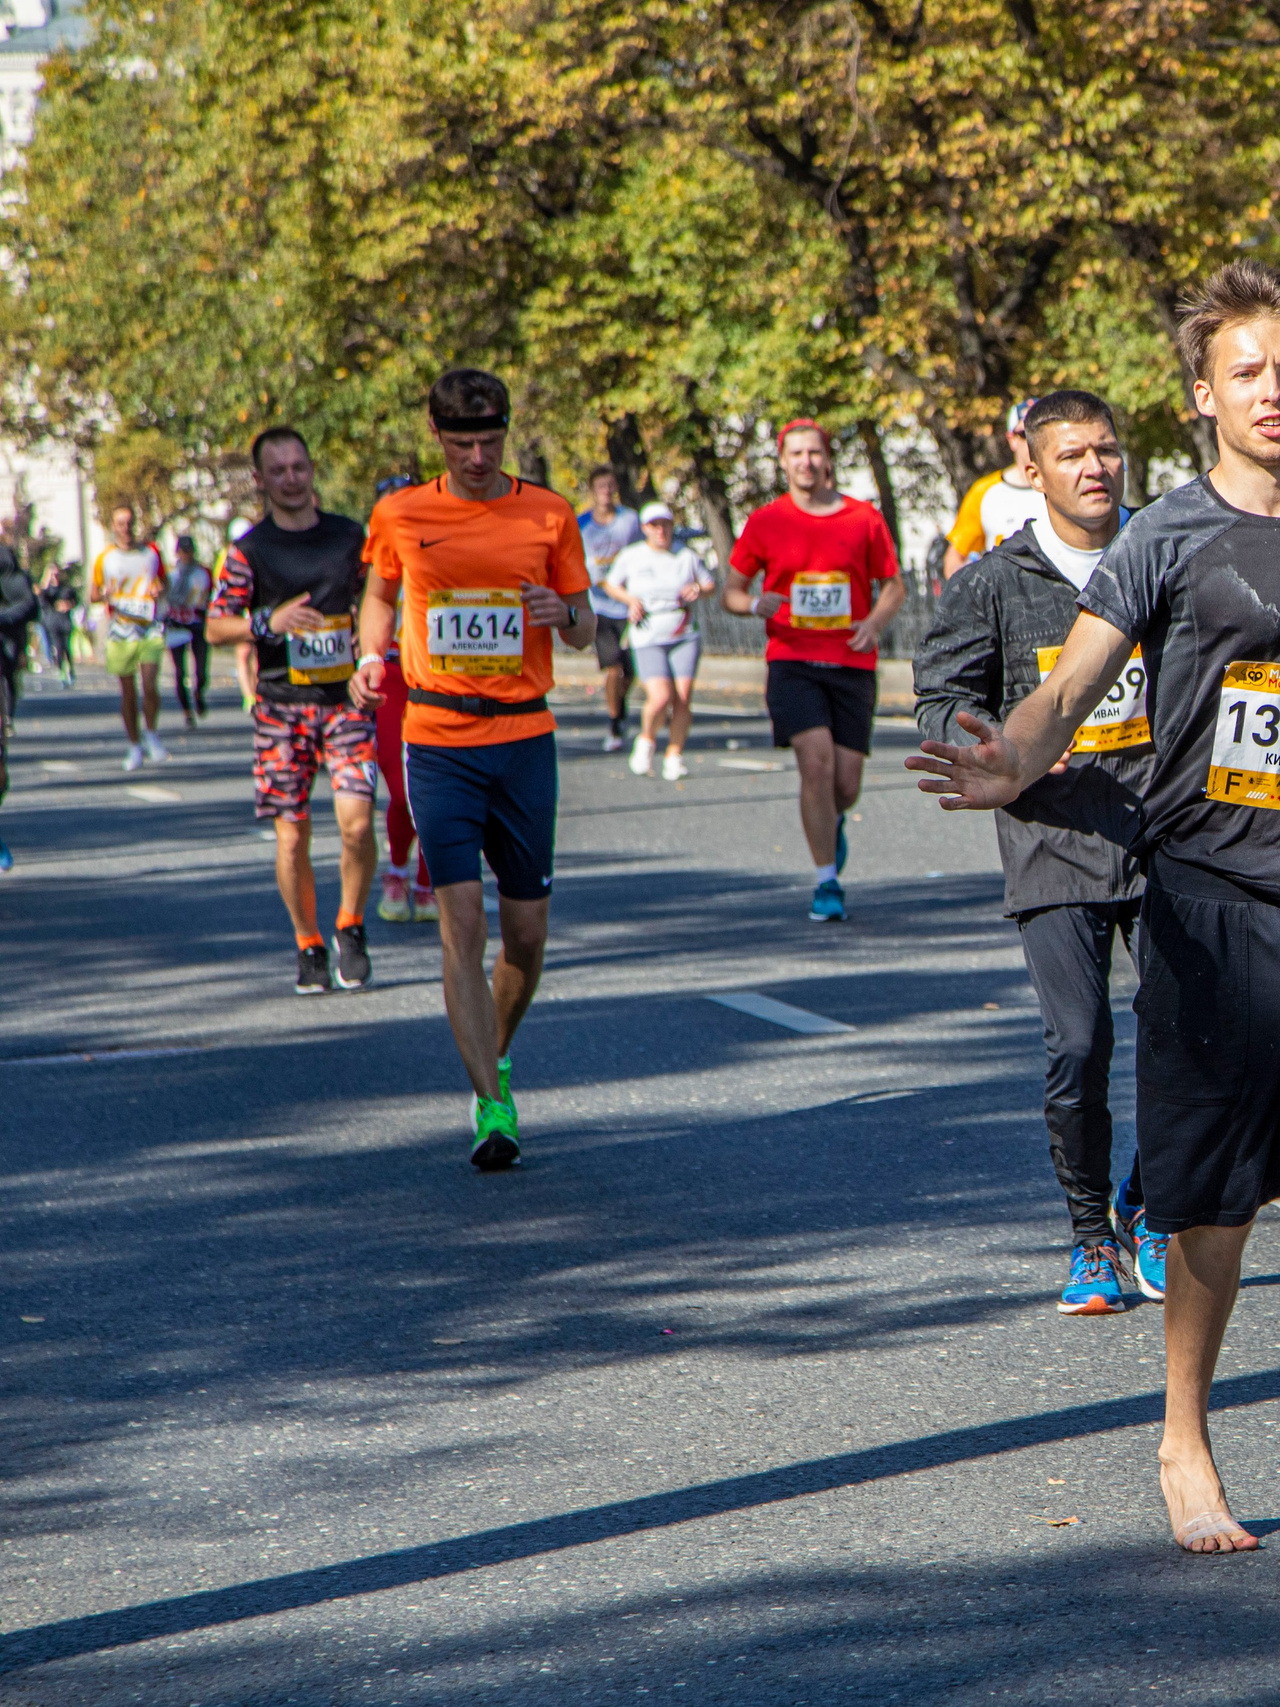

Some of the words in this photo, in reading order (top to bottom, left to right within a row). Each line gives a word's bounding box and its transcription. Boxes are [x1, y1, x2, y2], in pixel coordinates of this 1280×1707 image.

[798, 588, 842, 607] 7537
[433, 613, 520, 640] 11614
[299, 635, 345, 657] 6006
[452, 642, 499, 651] АЛЕКСАНДР
[1093, 707, 1120, 719] ИВАН
[1225, 771, 1243, 795] F
